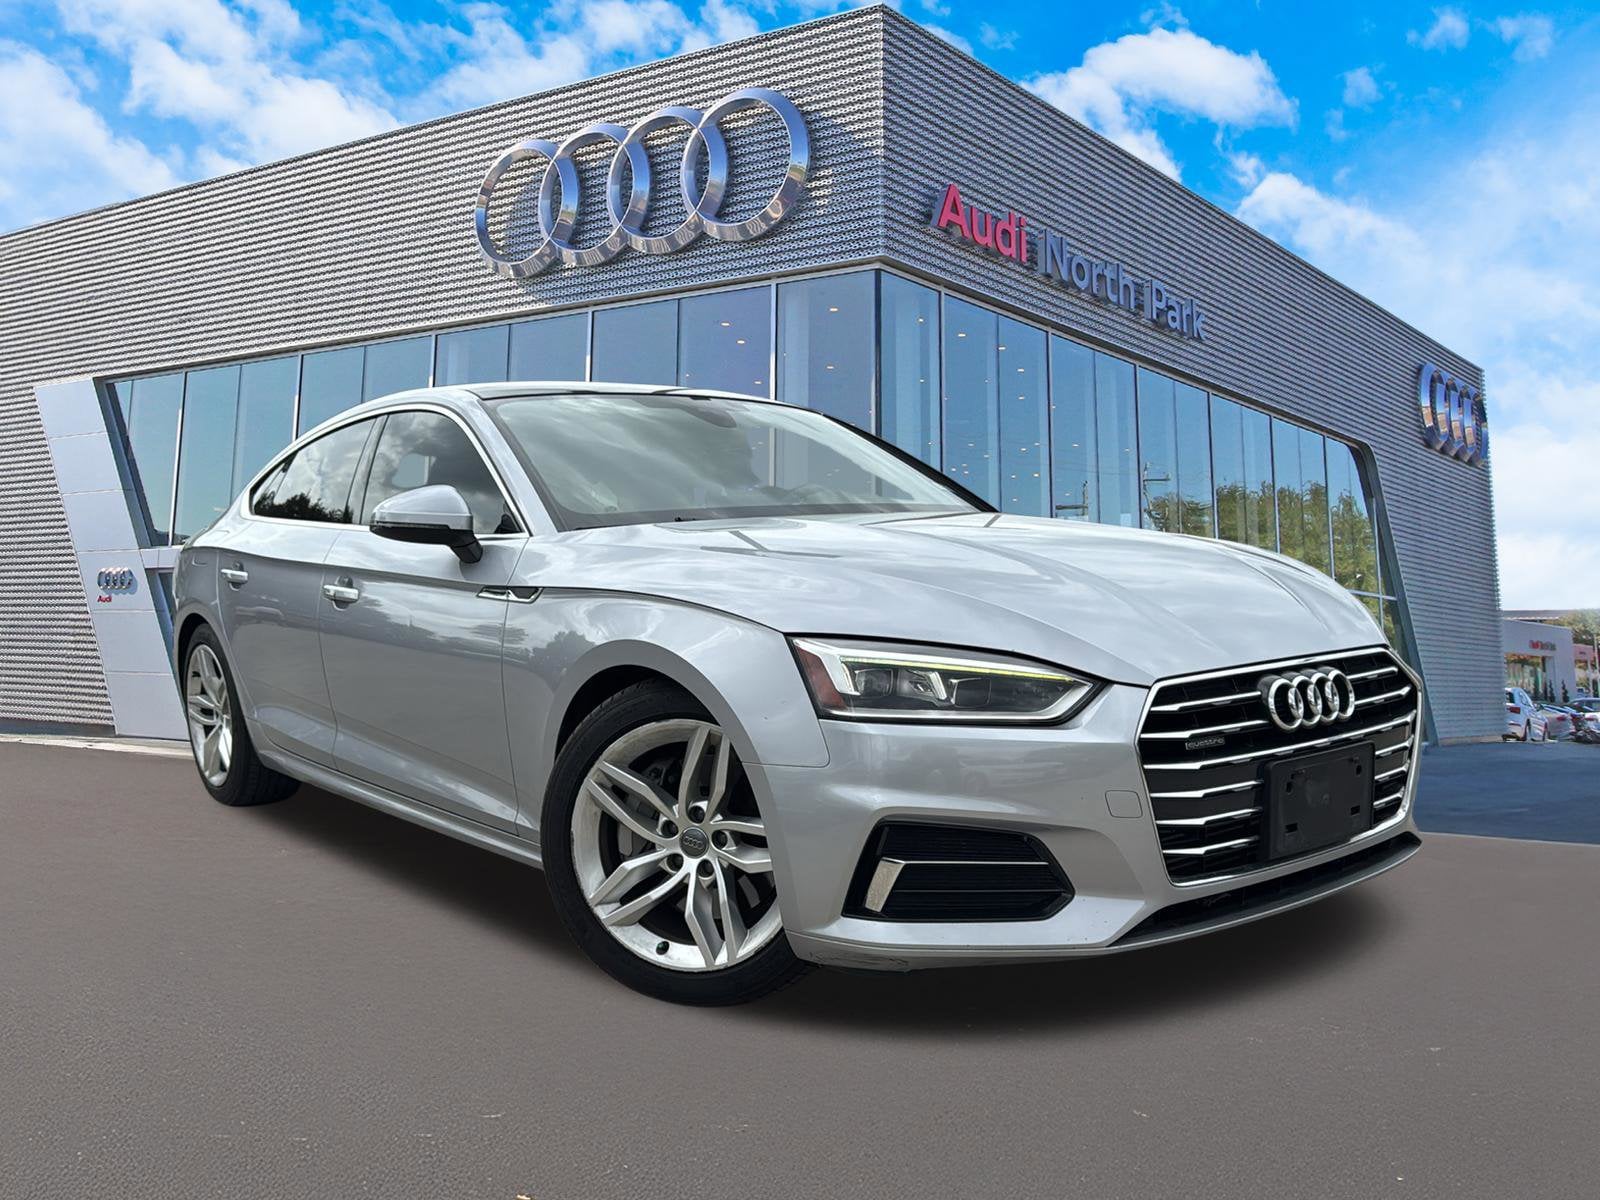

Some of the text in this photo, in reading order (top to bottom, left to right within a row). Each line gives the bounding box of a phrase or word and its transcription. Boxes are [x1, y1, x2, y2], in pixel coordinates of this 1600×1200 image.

[934, 183, 1206, 340] Audi North Park
[97, 594, 112, 602] Audi
